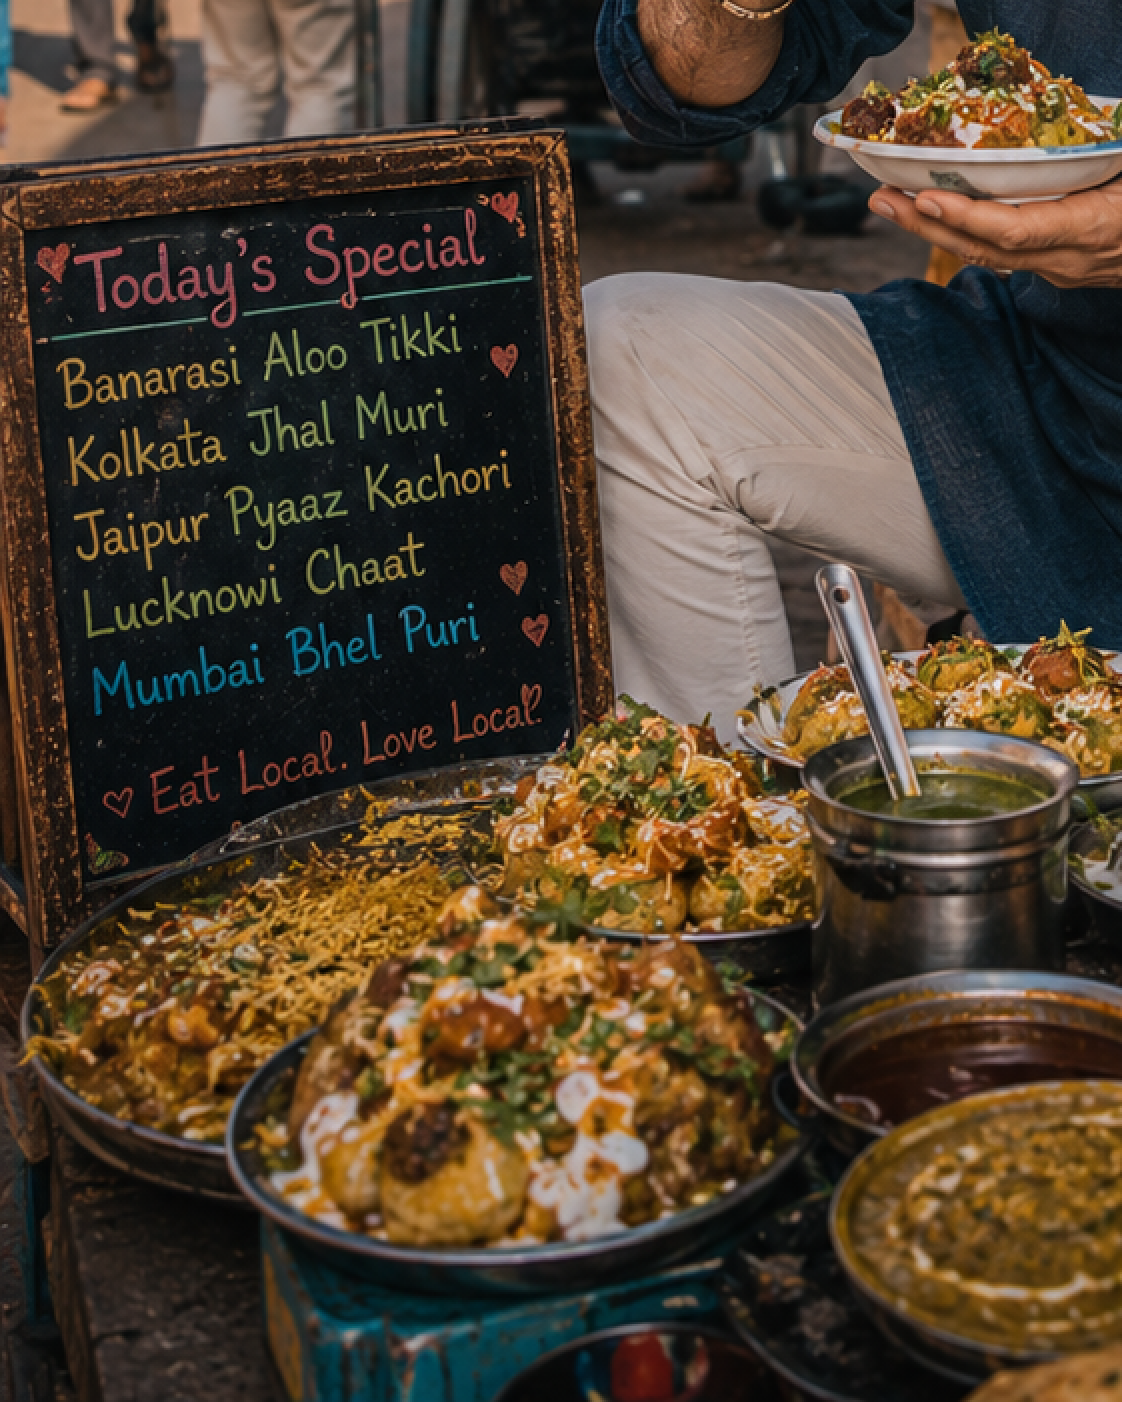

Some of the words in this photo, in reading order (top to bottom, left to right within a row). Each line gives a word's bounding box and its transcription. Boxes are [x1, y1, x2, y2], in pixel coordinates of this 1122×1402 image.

[74, 238, 277, 328] Today's
[304, 208, 486, 309] Special
[56, 346, 243, 410] Banarasi
[263, 329, 348, 382] Aloo
[360, 312, 463, 364] Tikki
[67, 419, 228, 486] Kolkata
[247, 400, 335, 457] Jhal
[355, 388, 449, 440] Muri
[73, 509, 209, 571] Jaipur
[224, 485, 349, 551] Pyaaz
[364, 449, 512, 512] Kachori
[83, 564, 282, 638] Lucknowi
[305, 532, 426, 595] Chaat
[90, 643, 265, 716] Mumbai
[286, 614, 382, 676] Bhel
[398, 602, 480, 653] Puri
[150, 755, 220, 815] Eat
[238, 729, 348, 796] Local.
[361, 721, 437, 766] Love
